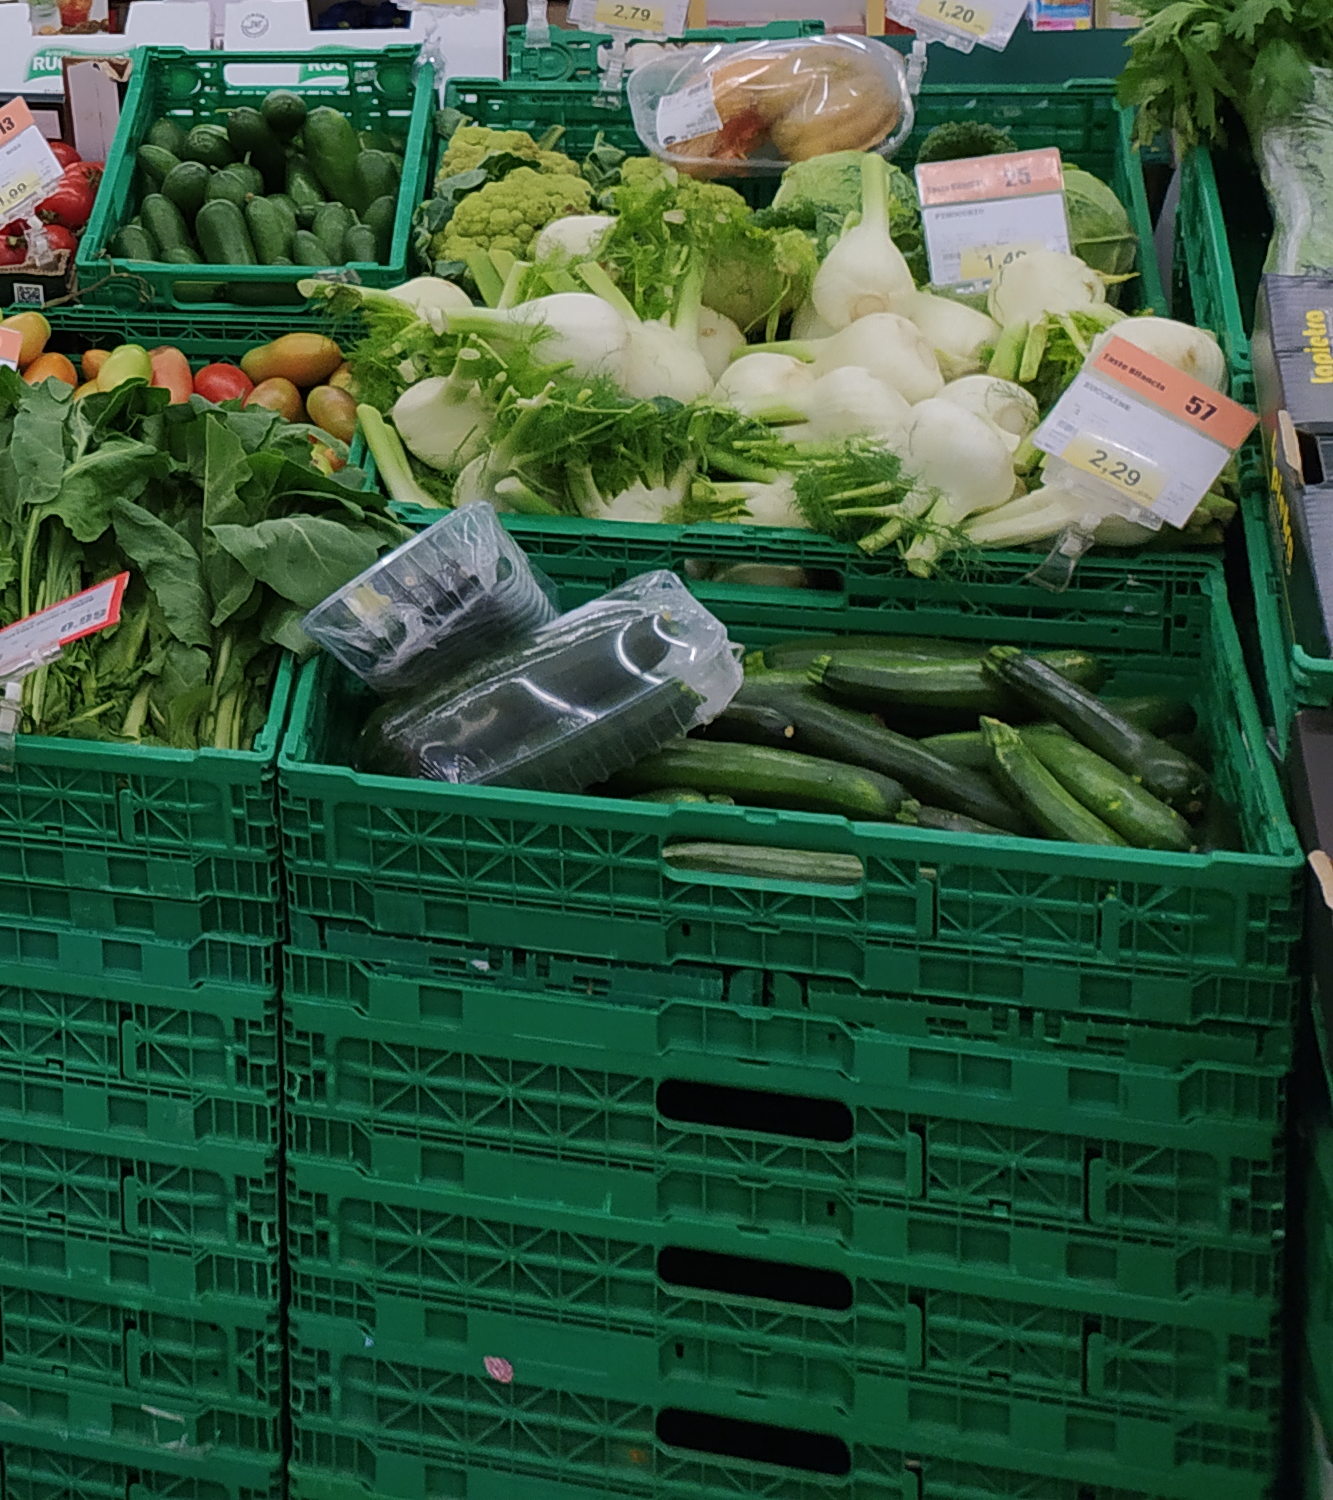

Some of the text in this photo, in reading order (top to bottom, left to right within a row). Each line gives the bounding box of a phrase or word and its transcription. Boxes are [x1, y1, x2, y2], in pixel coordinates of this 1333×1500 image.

[613, 4, 652, 22] 2,79
[937, 0, 976, 25] 1,20
[1003, 166, 1032, 188] 25
[1184, 395, 1219, 422] 57
[1088, 449, 1142, 488] 2,29
